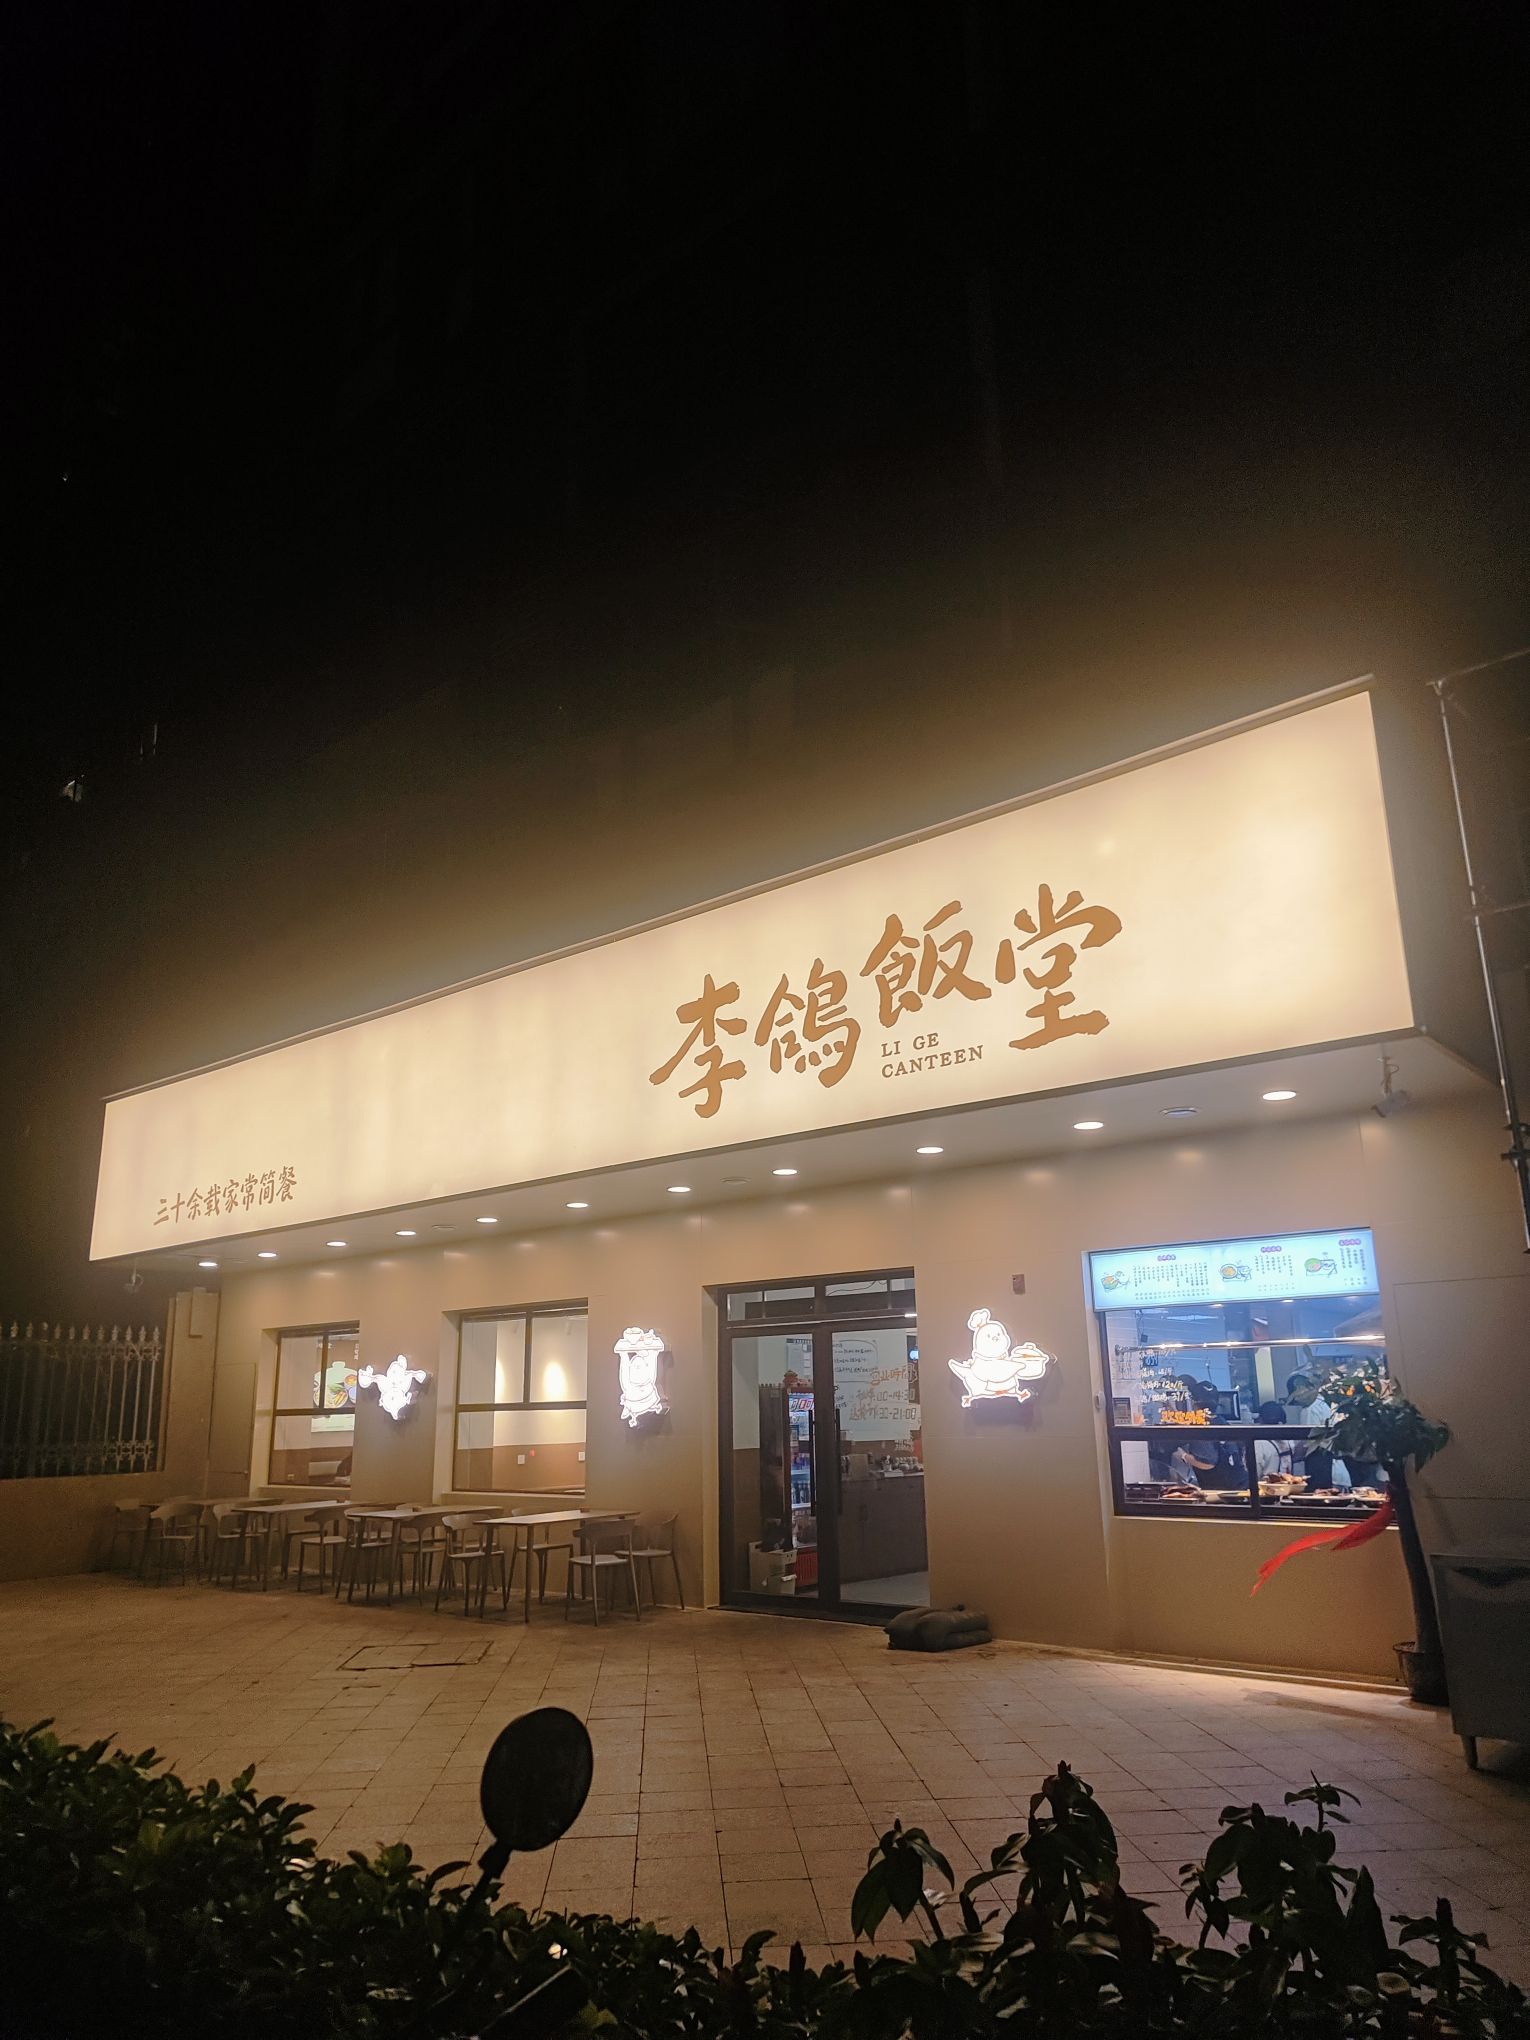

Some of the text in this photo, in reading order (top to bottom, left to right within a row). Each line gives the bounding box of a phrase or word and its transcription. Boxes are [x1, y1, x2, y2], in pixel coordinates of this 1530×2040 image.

[881, 1033, 940, 1058] LI GE
[881, 1045, 984, 1079] CANTEEN
